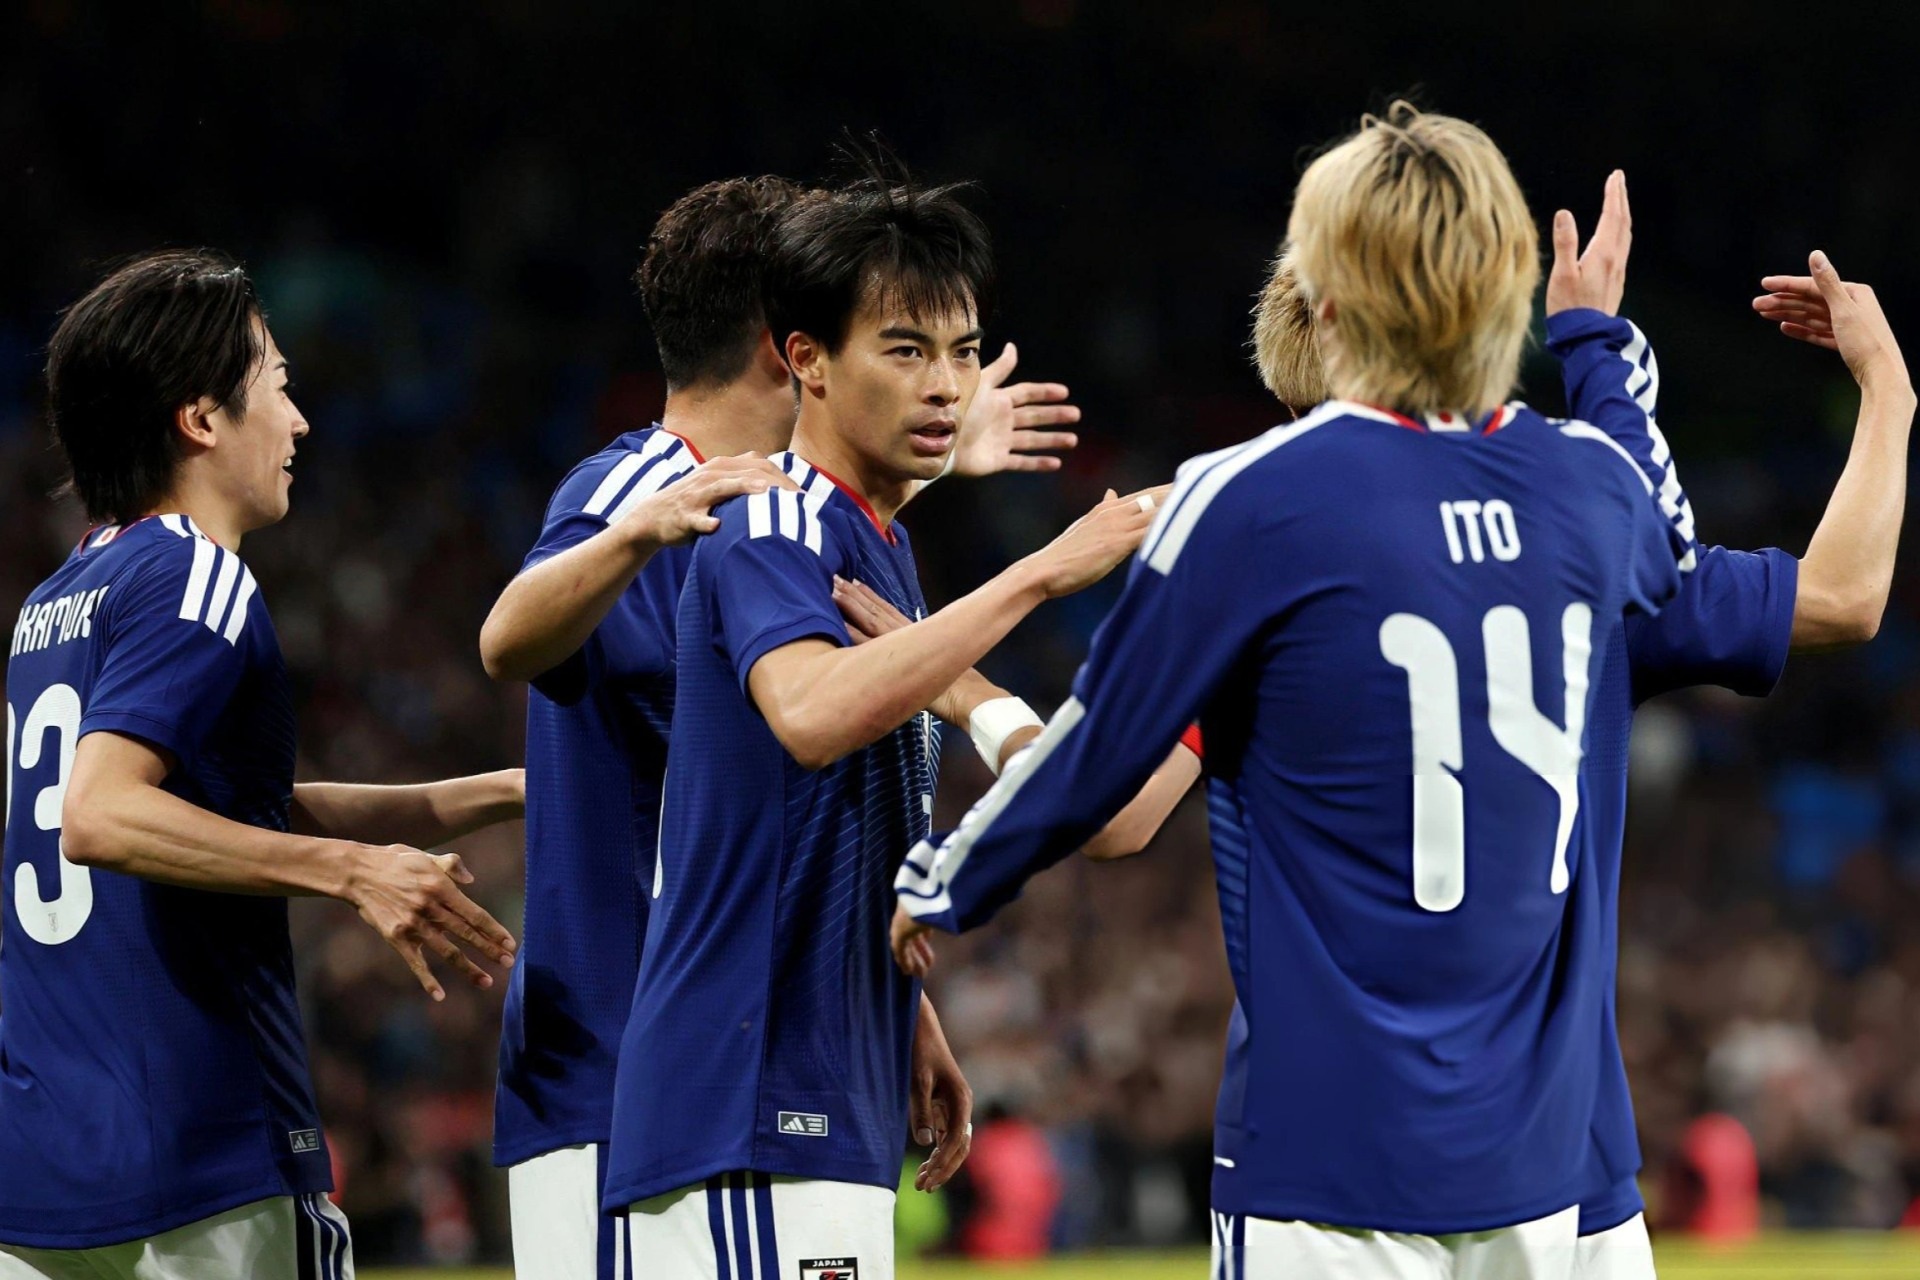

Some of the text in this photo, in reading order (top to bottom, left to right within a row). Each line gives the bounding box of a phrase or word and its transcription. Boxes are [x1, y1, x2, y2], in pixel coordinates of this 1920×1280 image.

[1439, 499, 1522, 564] ITO
[10, 585, 110, 657] KAMUR
[1379, 602, 1592, 912] 14
[812, 1259, 844, 1268] JAPAN
